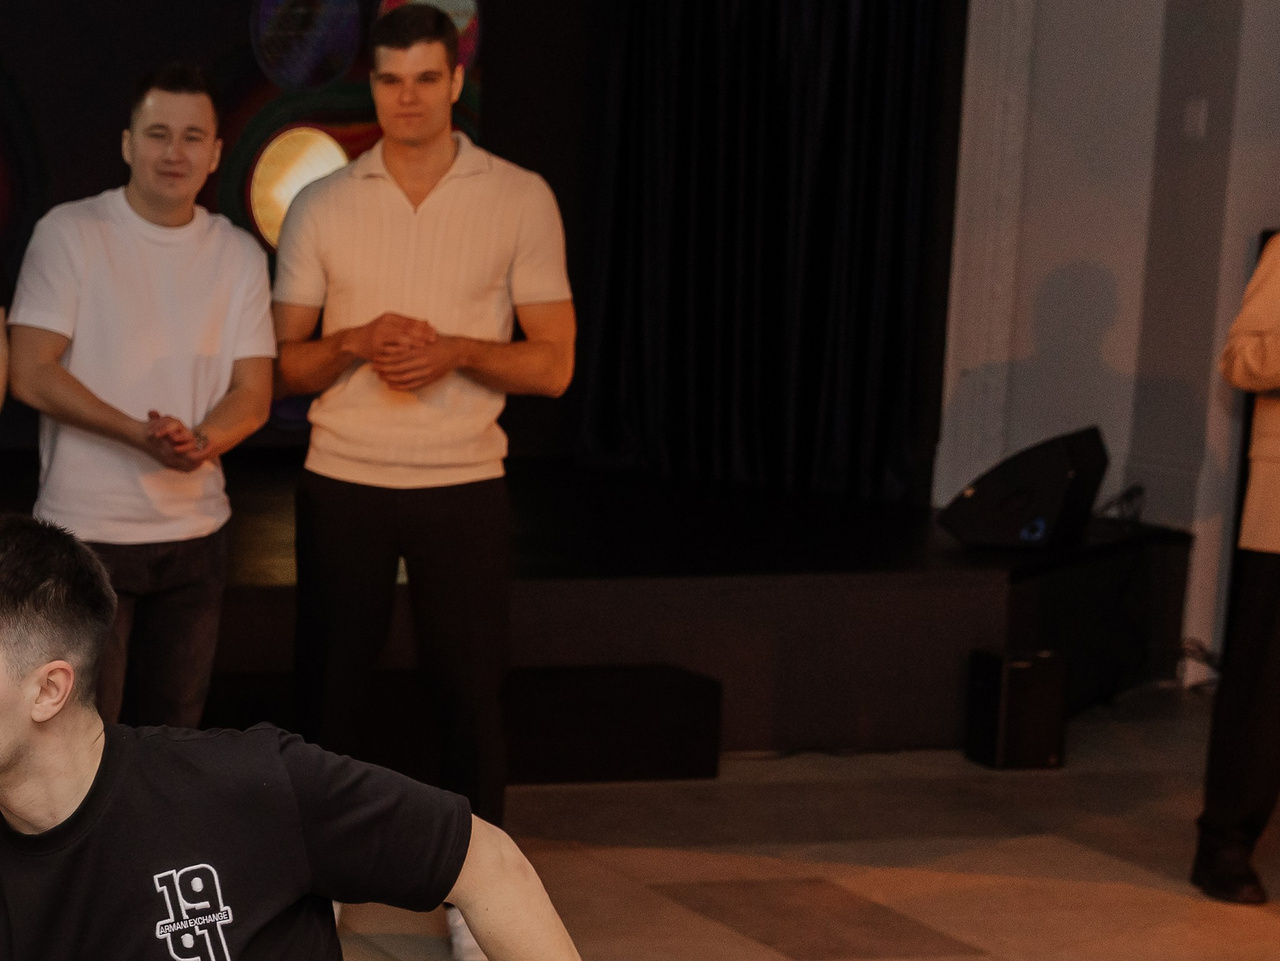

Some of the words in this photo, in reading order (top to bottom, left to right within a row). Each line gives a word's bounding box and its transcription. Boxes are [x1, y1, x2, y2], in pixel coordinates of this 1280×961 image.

[153, 863, 225, 920] 19
[159, 920, 189, 935] ARMANI
[188, 911, 228, 927] EXCHANGE
